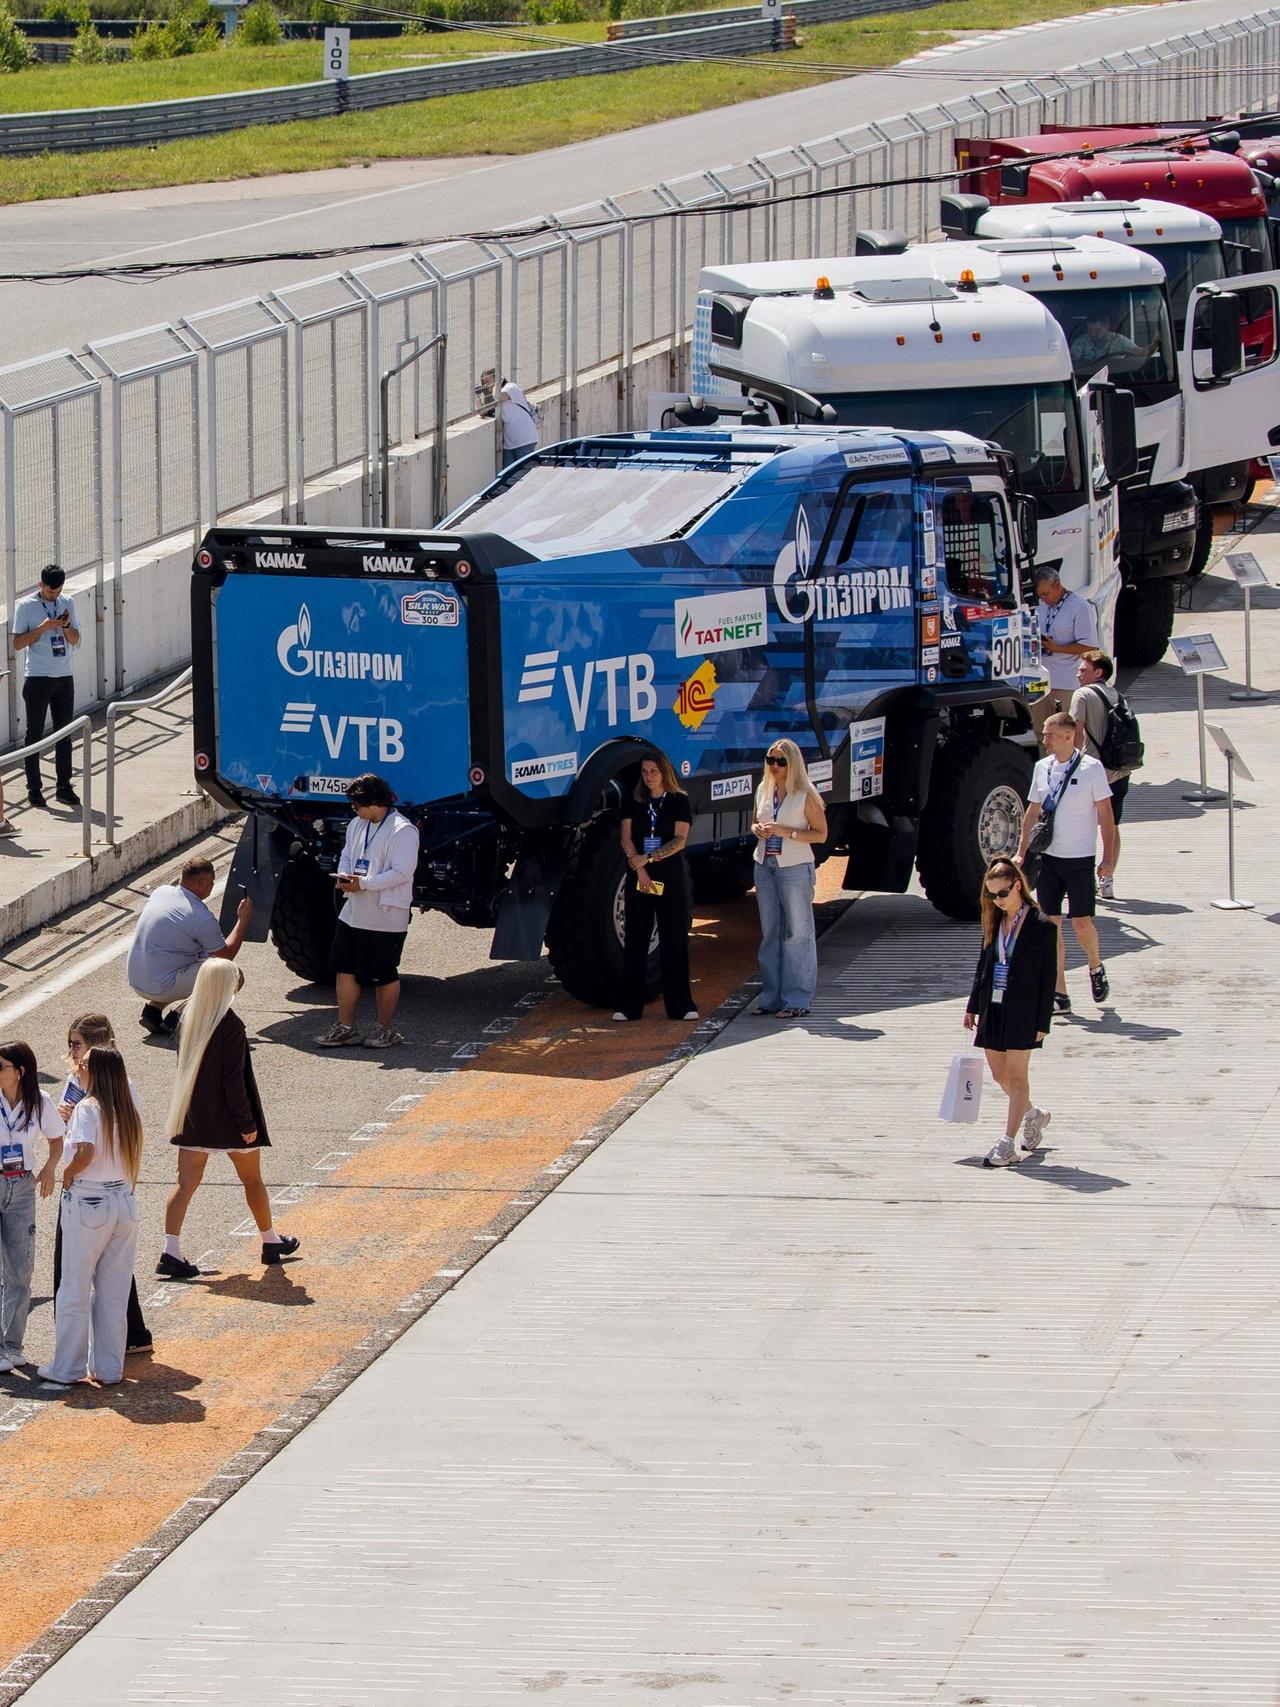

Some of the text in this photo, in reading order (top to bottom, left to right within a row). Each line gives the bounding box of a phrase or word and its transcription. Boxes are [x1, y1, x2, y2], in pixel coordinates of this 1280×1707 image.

[330, 36, 342, 70] 100
[1051, 527, 1082, 536] NEO
[255, 552, 307, 569] KAMAZ
[363, 555, 415, 573] KAMAZ
[814, 565, 911, 621] ГАЗПРОМ
[408, 602, 452, 611] SILK WAY
[422, 616, 438, 624] 300
[718, 612, 762, 625] FUEL PARTNER
[695, 622, 762, 645] TATNEFT
[941, 636, 961, 649] KAMAZ
[314, 650, 403, 681] ГАЗПРОМ
[994, 635, 1020, 677] 300
[562, 653, 657, 732] VTB
[319, 714, 405, 763] VTB
